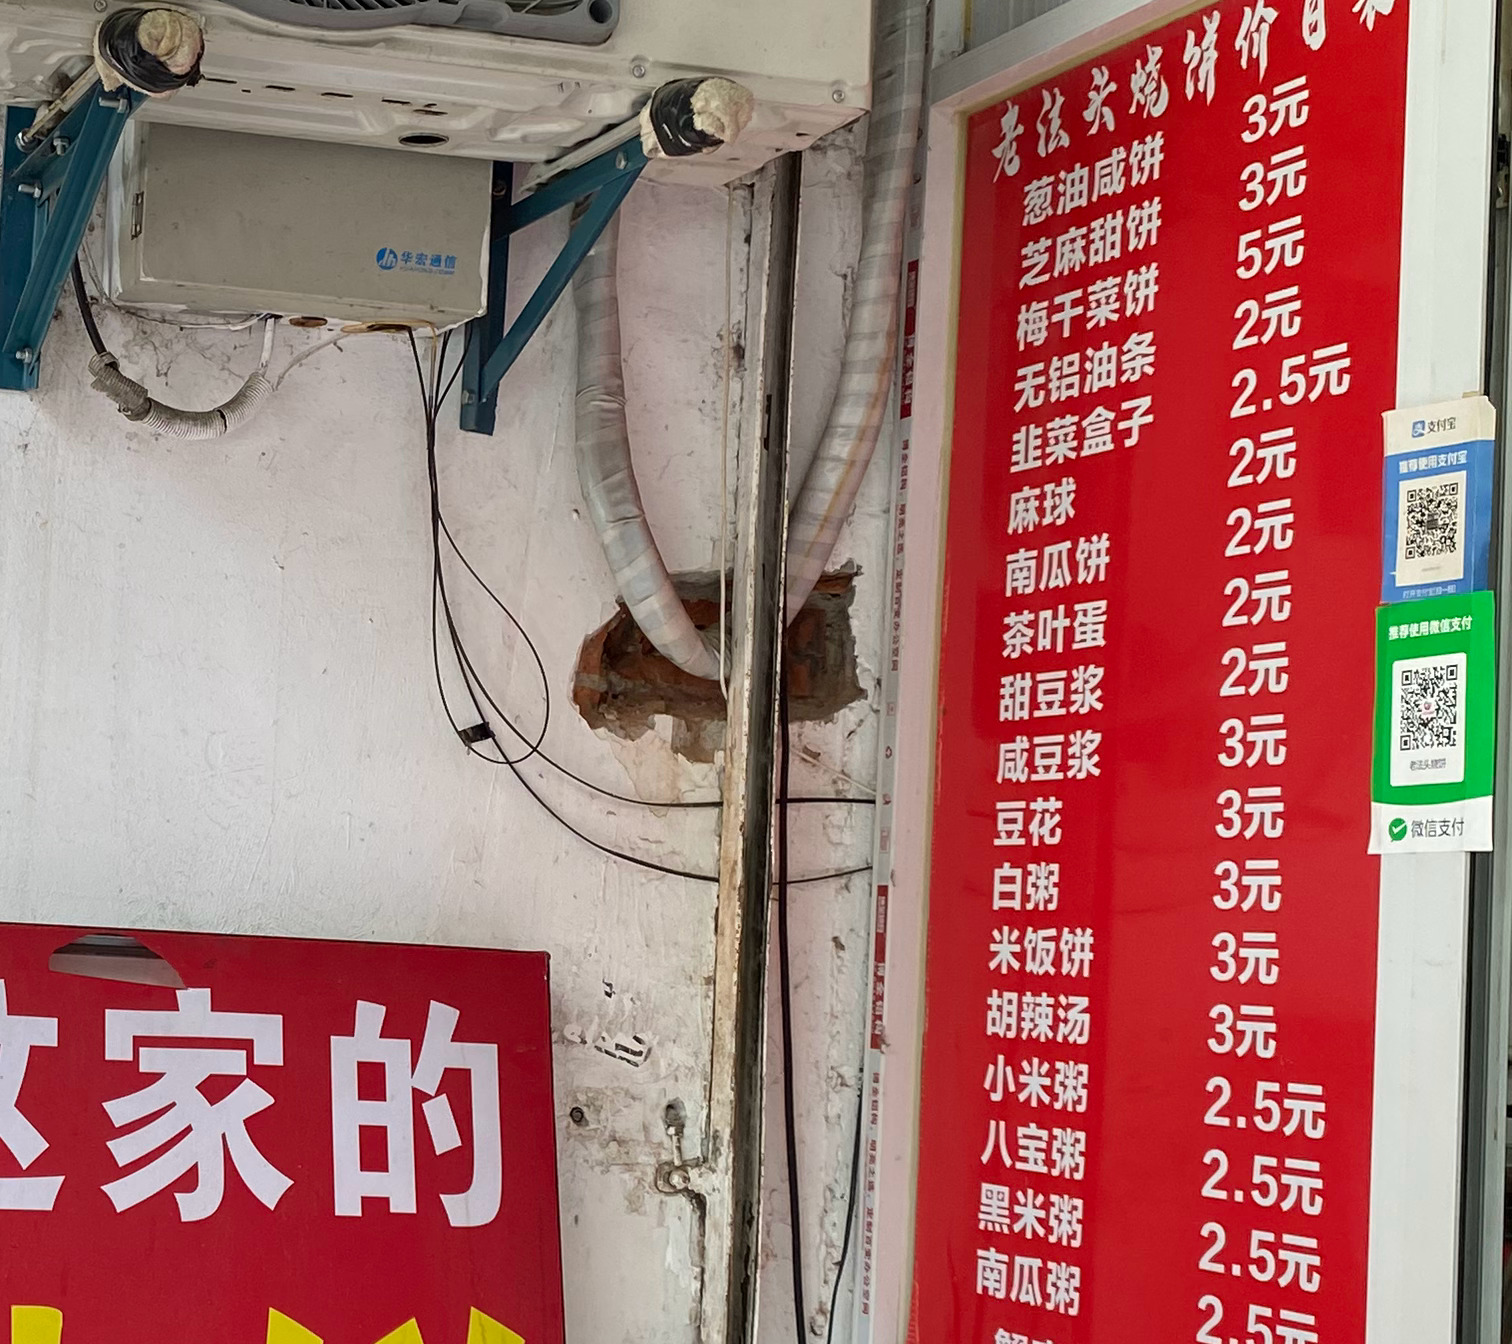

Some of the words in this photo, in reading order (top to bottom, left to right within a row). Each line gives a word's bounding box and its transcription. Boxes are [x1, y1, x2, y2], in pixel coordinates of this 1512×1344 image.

[1021, 131, 1165, 226] 葱油咸饼
[1240, 75, 1310, 144] 3元
[1019, 196, 1162, 290] 芝麻甜饼
[1238, 145, 1308, 212] 3元
[1016, 262, 1160, 352] 梅干菜饼
[1236, 215, 1306, 280] 5元
[1013, 331, 1157, 414] 无铝油条
[1232, 285, 1302, 351] 2元
[1009, 395, 1154, 474] 韭菜盒子
[1230, 342, 1352, 419] 2.5元
[1427, 416, 1457, 434] 支付宝
[1006, 476, 1077, 535] 麻球
[1227, 426, 1297, 488] 2元
[1398, 450, 1468, 474] 推荐使用支付宝
[1004, 532, 1111, 597] 南瓜饼
[1224, 498, 1295, 557] 2元
[1001, 599, 1108, 659] 茶叶蛋
[1221, 569, 1292, 628] 2元
[1388, 615, 1473, 641] 推荐使用微信支付
[998, 664, 1105, 722] 甜豆浆
[1219, 641, 1289, 697] 2元
[996, 729, 1103, 784] 咸豆浆
[1217, 713, 1288, 768] 3元
[993, 796, 1063, 846] 豆花
[1214, 786, 1285, 840] 3元
[1411, 818, 1465, 839] 微信支付
[992, 861, 1060, 911] 白粥
[1212, 859, 1282, 913] 3元
[988, 925, 1094, 978] 米饭饼
[1209, 931, 1280, 985] 3元
[986, 989, 1090, 1045] 胡辣汤
[1207, 1003, 1277, 1059] 3元
[983, 1054, 1089, 1113] 小米粥
[1203, 1076, 1327, 1139] 2.5元
[980, 1119, 1087, 1181] 八宝粥
[1201, 1148, 1324, 1216] 2.5元
[978, 1182, 1084, 1248] 黑米粥
[1198, 1221, 1321, 1293] 2.5元
[975, 1247, 1081, 1317] 南瓜粥
